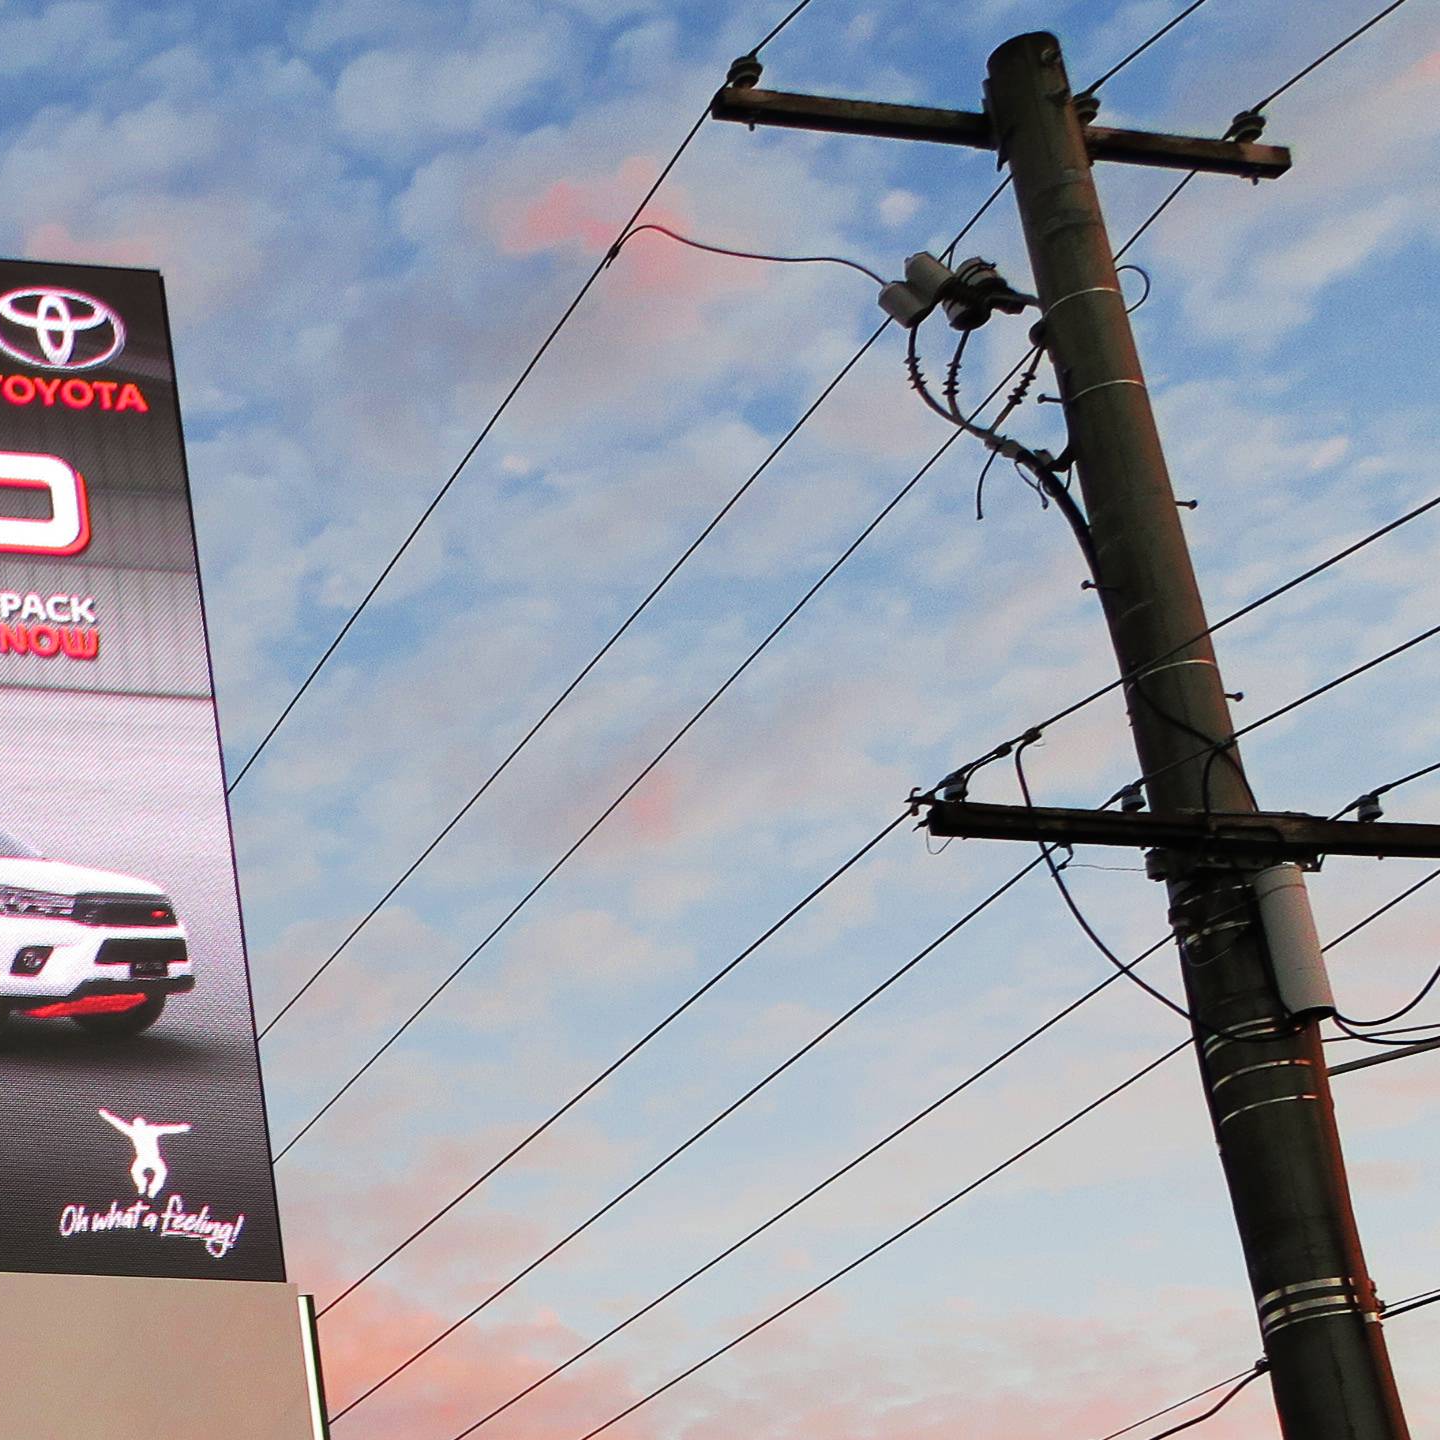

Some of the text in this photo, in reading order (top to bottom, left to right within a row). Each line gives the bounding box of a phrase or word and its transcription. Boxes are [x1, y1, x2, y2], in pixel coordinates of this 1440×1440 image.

[0, 590, 97, 624] PACK
[60, 1197, 246, 1258] Oh what a feeling!
